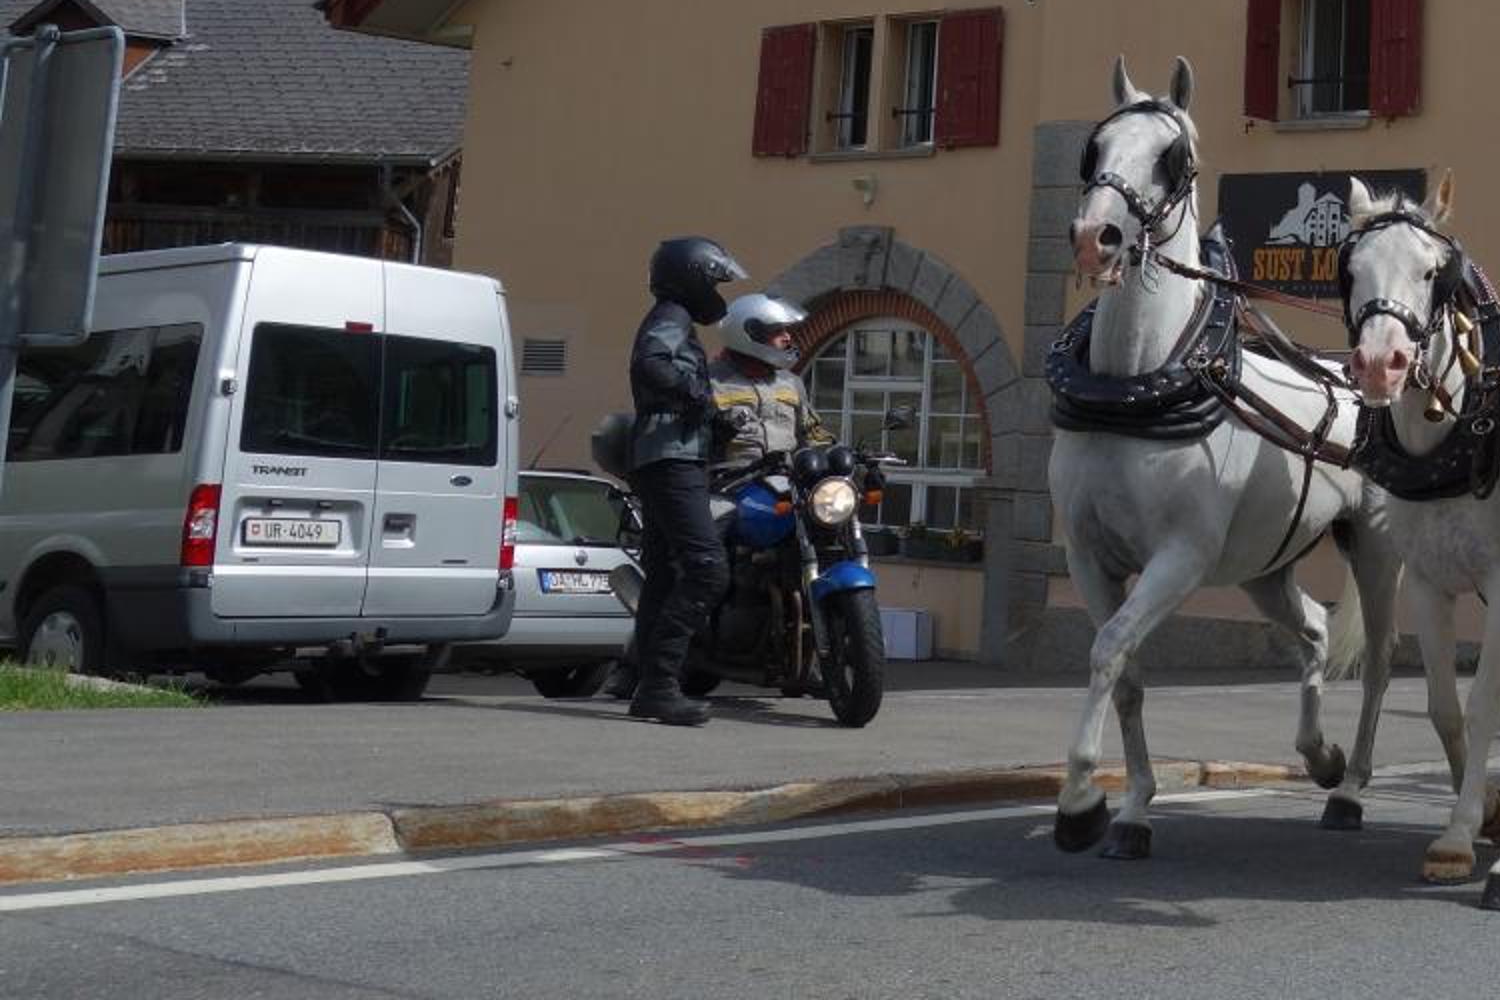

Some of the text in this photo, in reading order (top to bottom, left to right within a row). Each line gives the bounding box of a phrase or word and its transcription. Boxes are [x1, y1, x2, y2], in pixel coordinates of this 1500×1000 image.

[1253, 247, 1340, 281] SUST LO
[252, 465, 308, 477] TRANSIT
